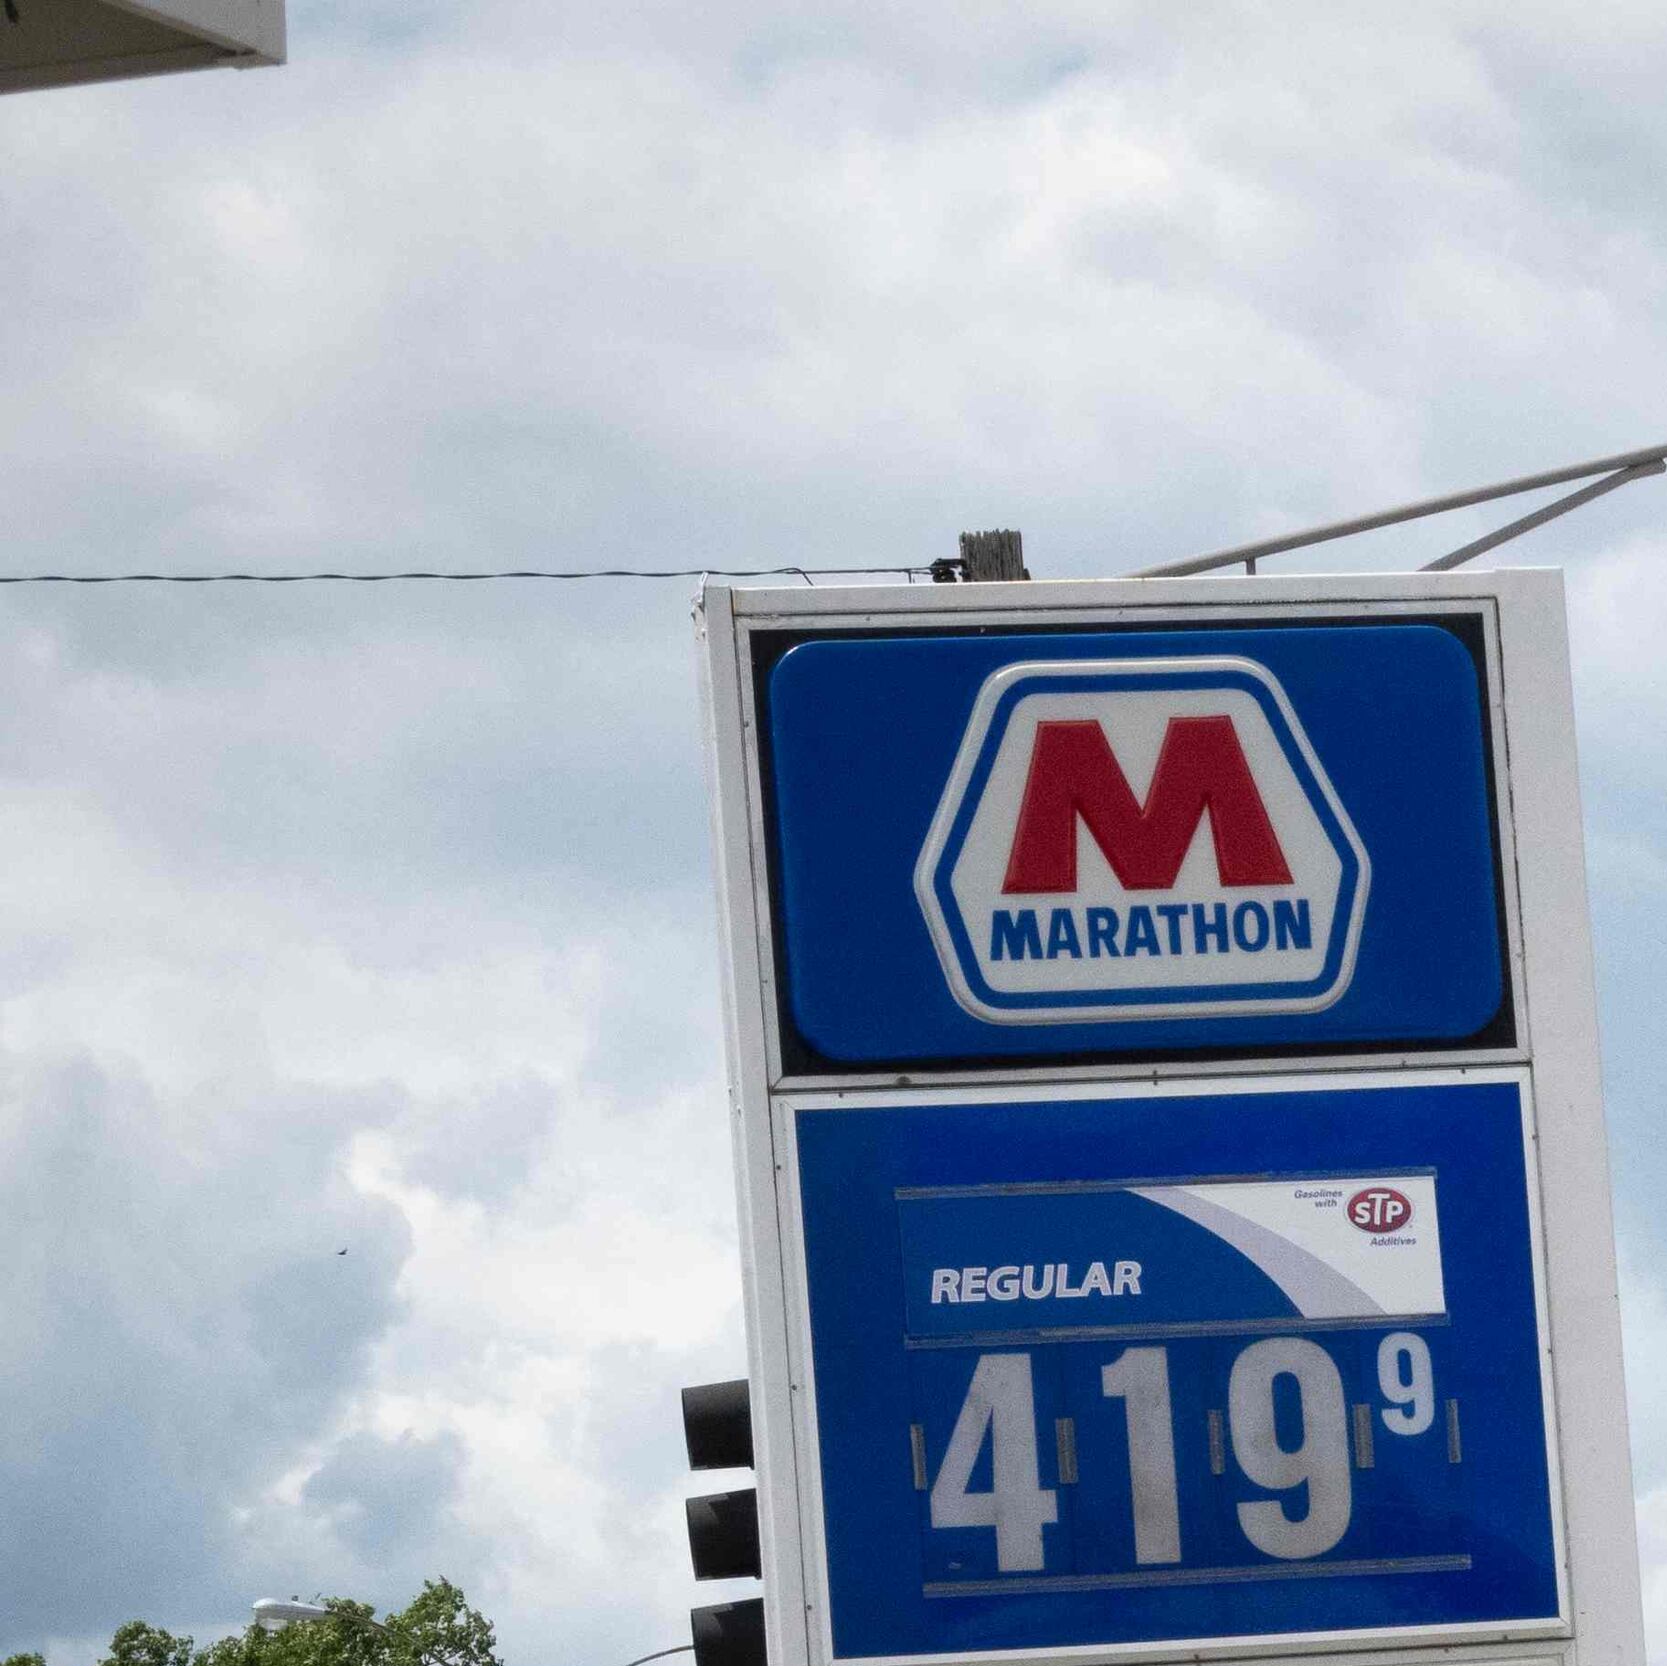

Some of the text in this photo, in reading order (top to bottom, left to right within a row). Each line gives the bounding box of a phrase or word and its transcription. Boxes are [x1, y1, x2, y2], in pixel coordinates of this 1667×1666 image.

[1002, 714, 1294, 894] M
[990, 898, 1312, 962] MARATHON
[1294, 1189, 1343, 1199] Gasolines
[1314, 1199, 1337, 1208] with
[1353, 1192, 1404, 1226] STP
[1369, 1236, 1417, 1247] Additives
[930, 1259, 1143, 1305] REGULAR
